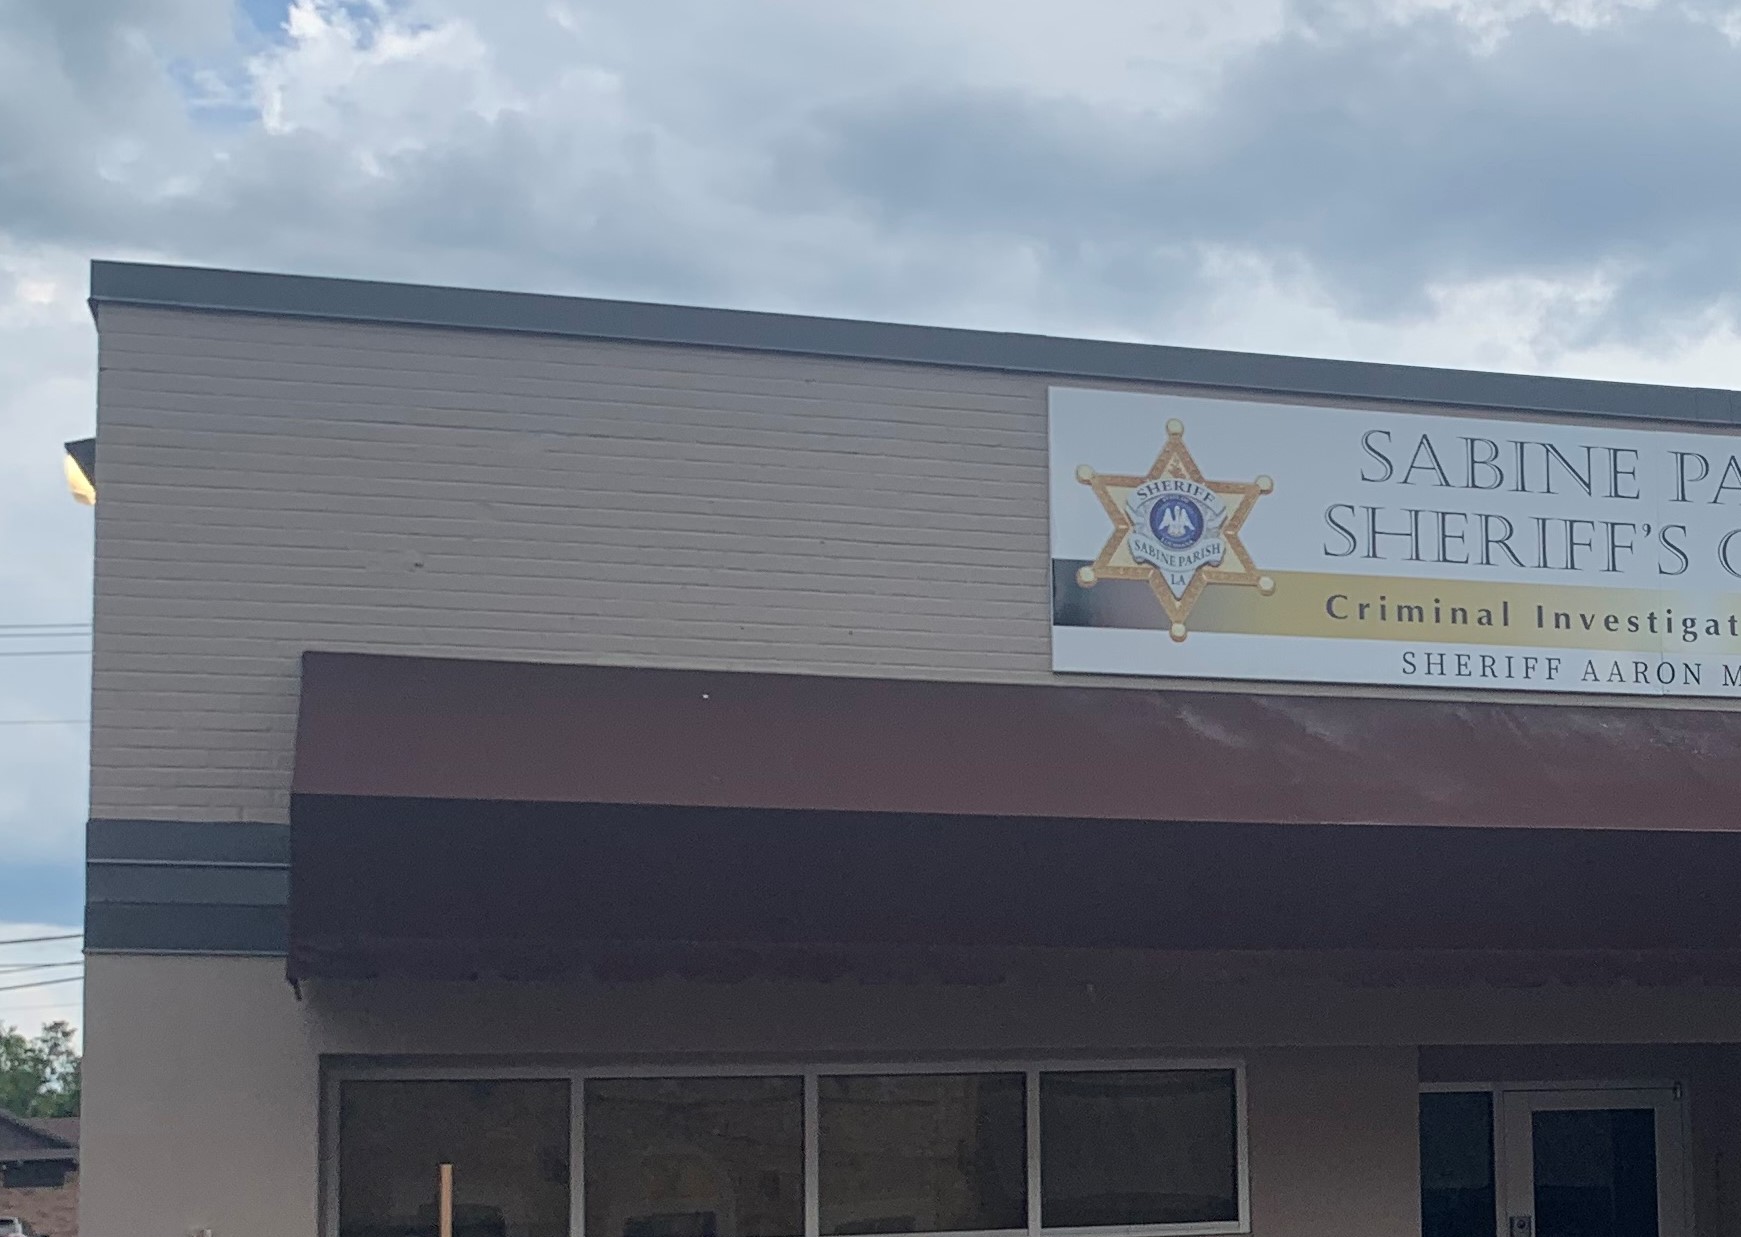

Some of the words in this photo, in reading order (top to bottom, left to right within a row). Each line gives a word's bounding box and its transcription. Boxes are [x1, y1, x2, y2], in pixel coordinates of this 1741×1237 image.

[1360, 429, 1640, 500] SABINE
[1137, 480, 1216, 503] SHERIFF
[1134, 538, 1176, 567] SABINE
[1179, 543, 1221, 567] PARISH
[1323, 503, 1689, 575] SHERIFF'S
[1171, 573, 1186, 586] LA
[1325, 594, 1509, 627] Criminal
[1402, 651, 1562, 681] SHERIFF
[1582, 659, 1702, 685] AARON
